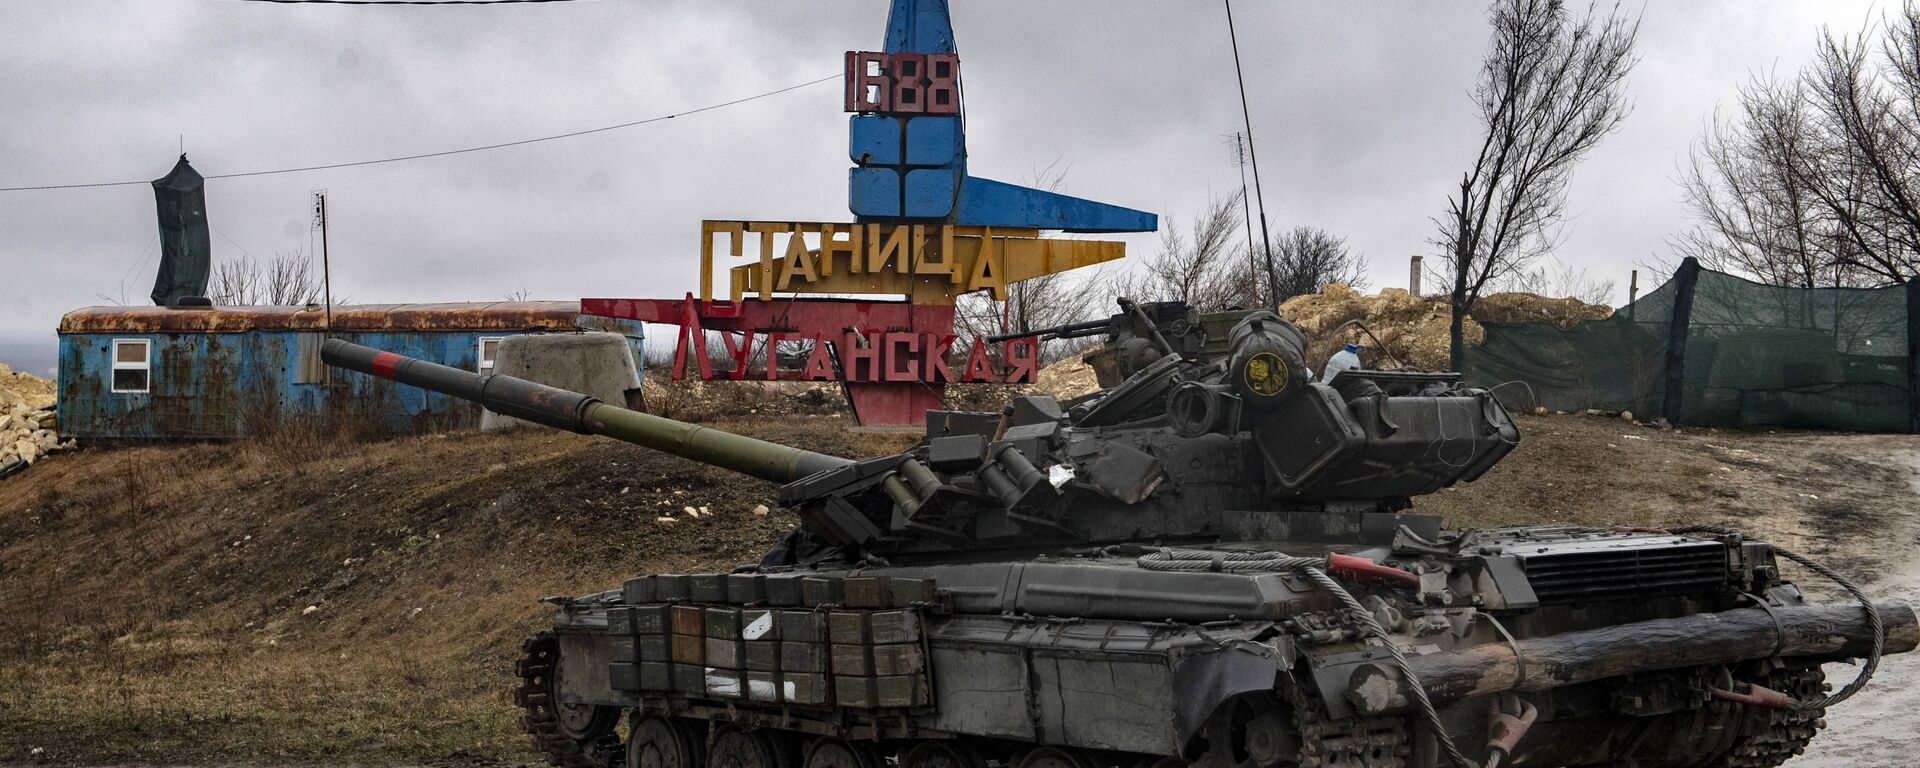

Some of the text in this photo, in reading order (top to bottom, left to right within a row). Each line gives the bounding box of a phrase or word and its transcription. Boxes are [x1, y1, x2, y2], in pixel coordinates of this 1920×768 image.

[844, 51, 959, 112] 1688
[702, 220, 1007, 316] СТАНИЦА
[672, 292, 1038, 383] ЛУГАНСКАЯ
